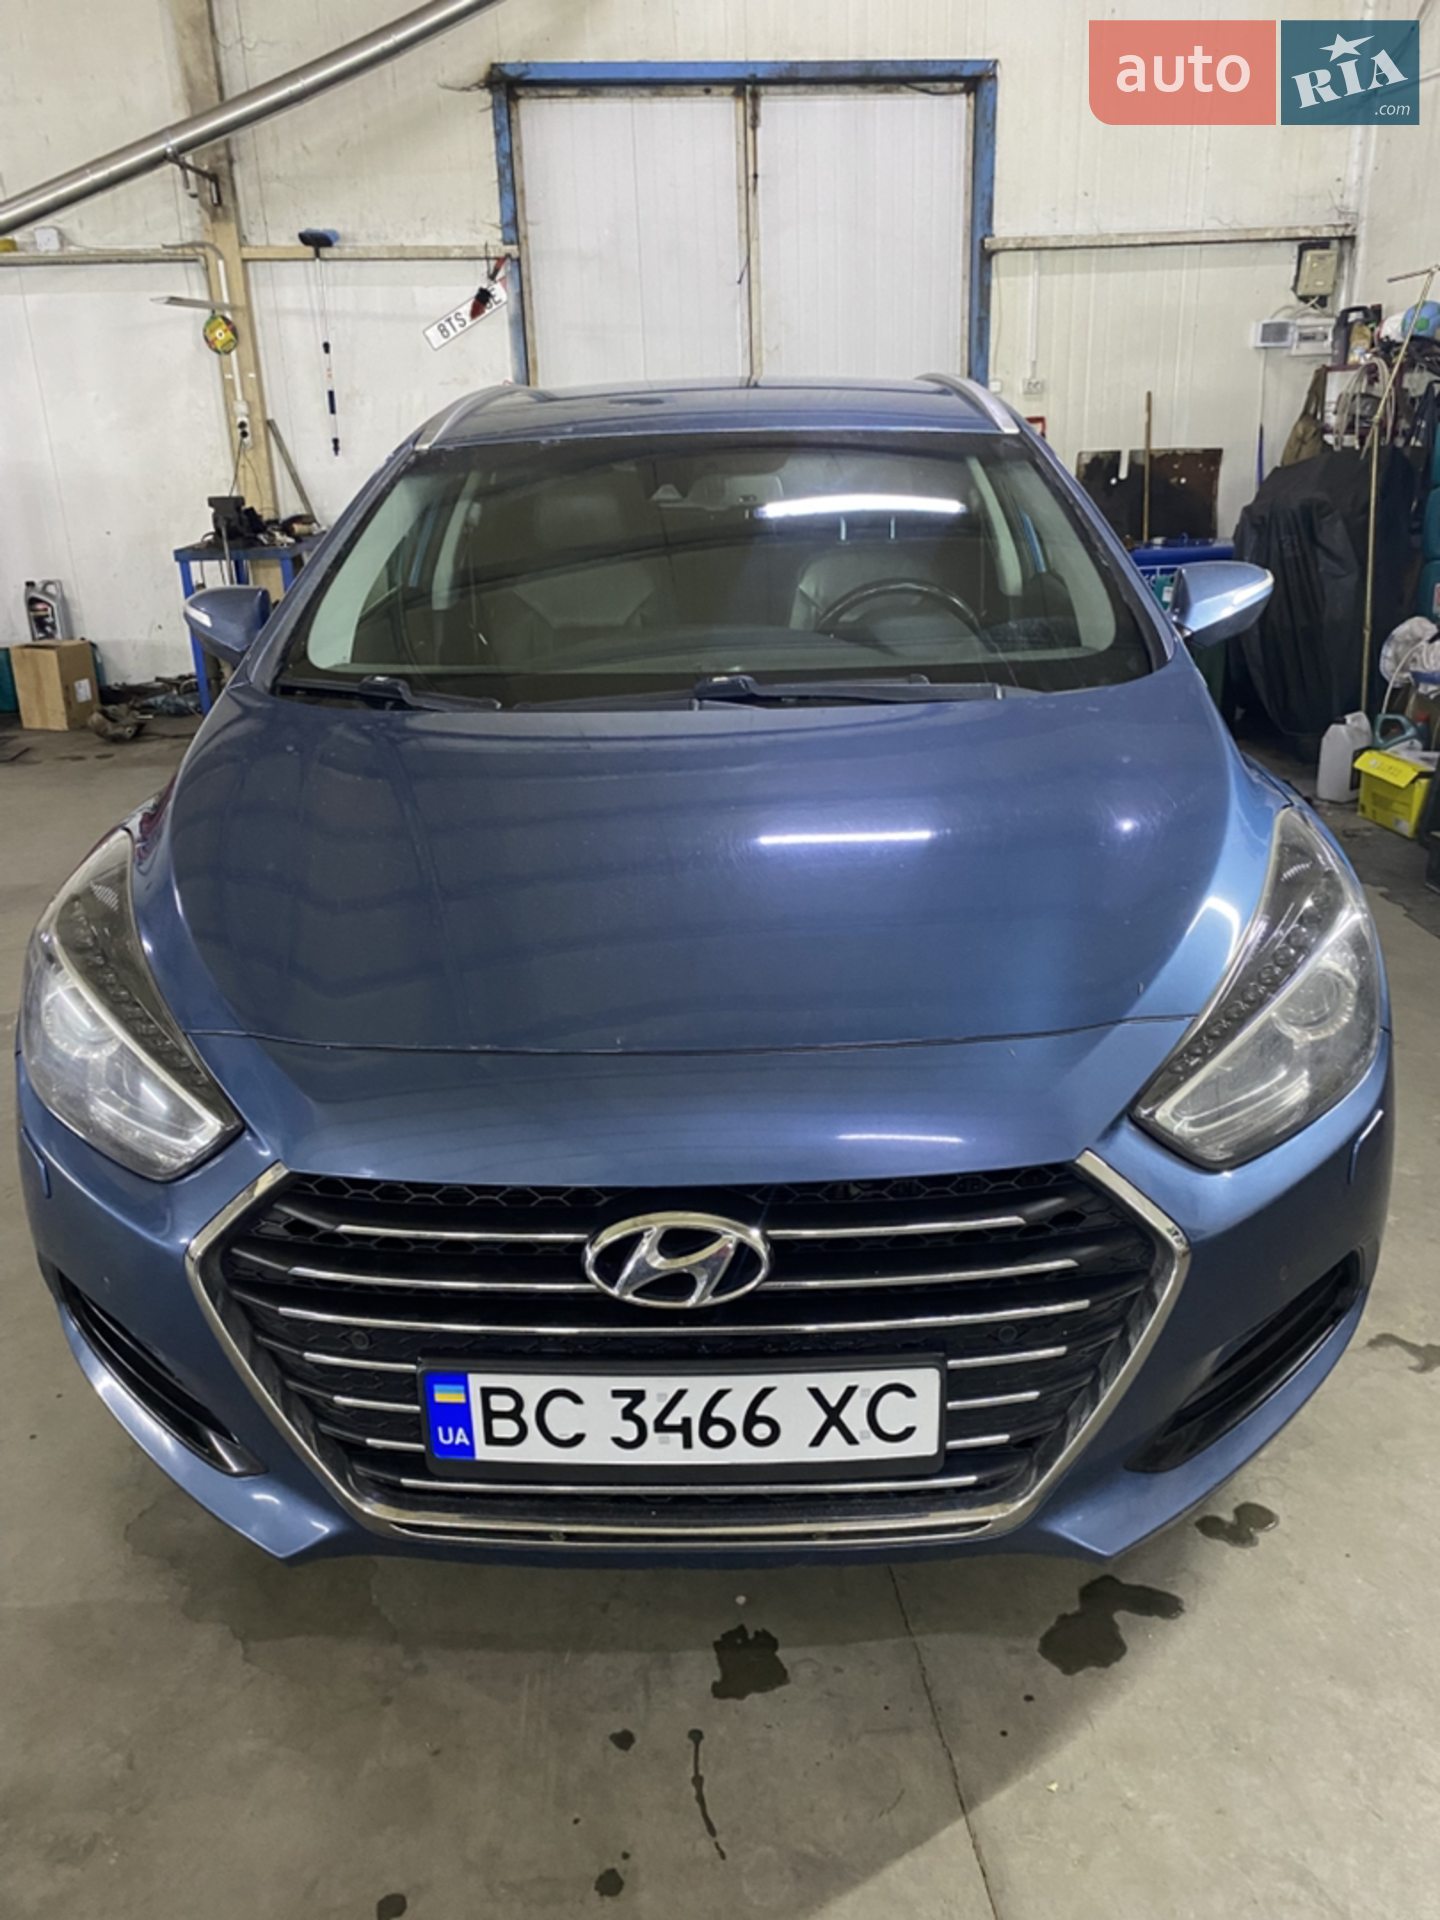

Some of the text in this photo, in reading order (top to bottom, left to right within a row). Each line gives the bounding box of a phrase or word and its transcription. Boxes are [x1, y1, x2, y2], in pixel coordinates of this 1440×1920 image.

[437, 1427, 470, 1446] UA
[479, 1383, 917, 1449] BC 3466 XC
